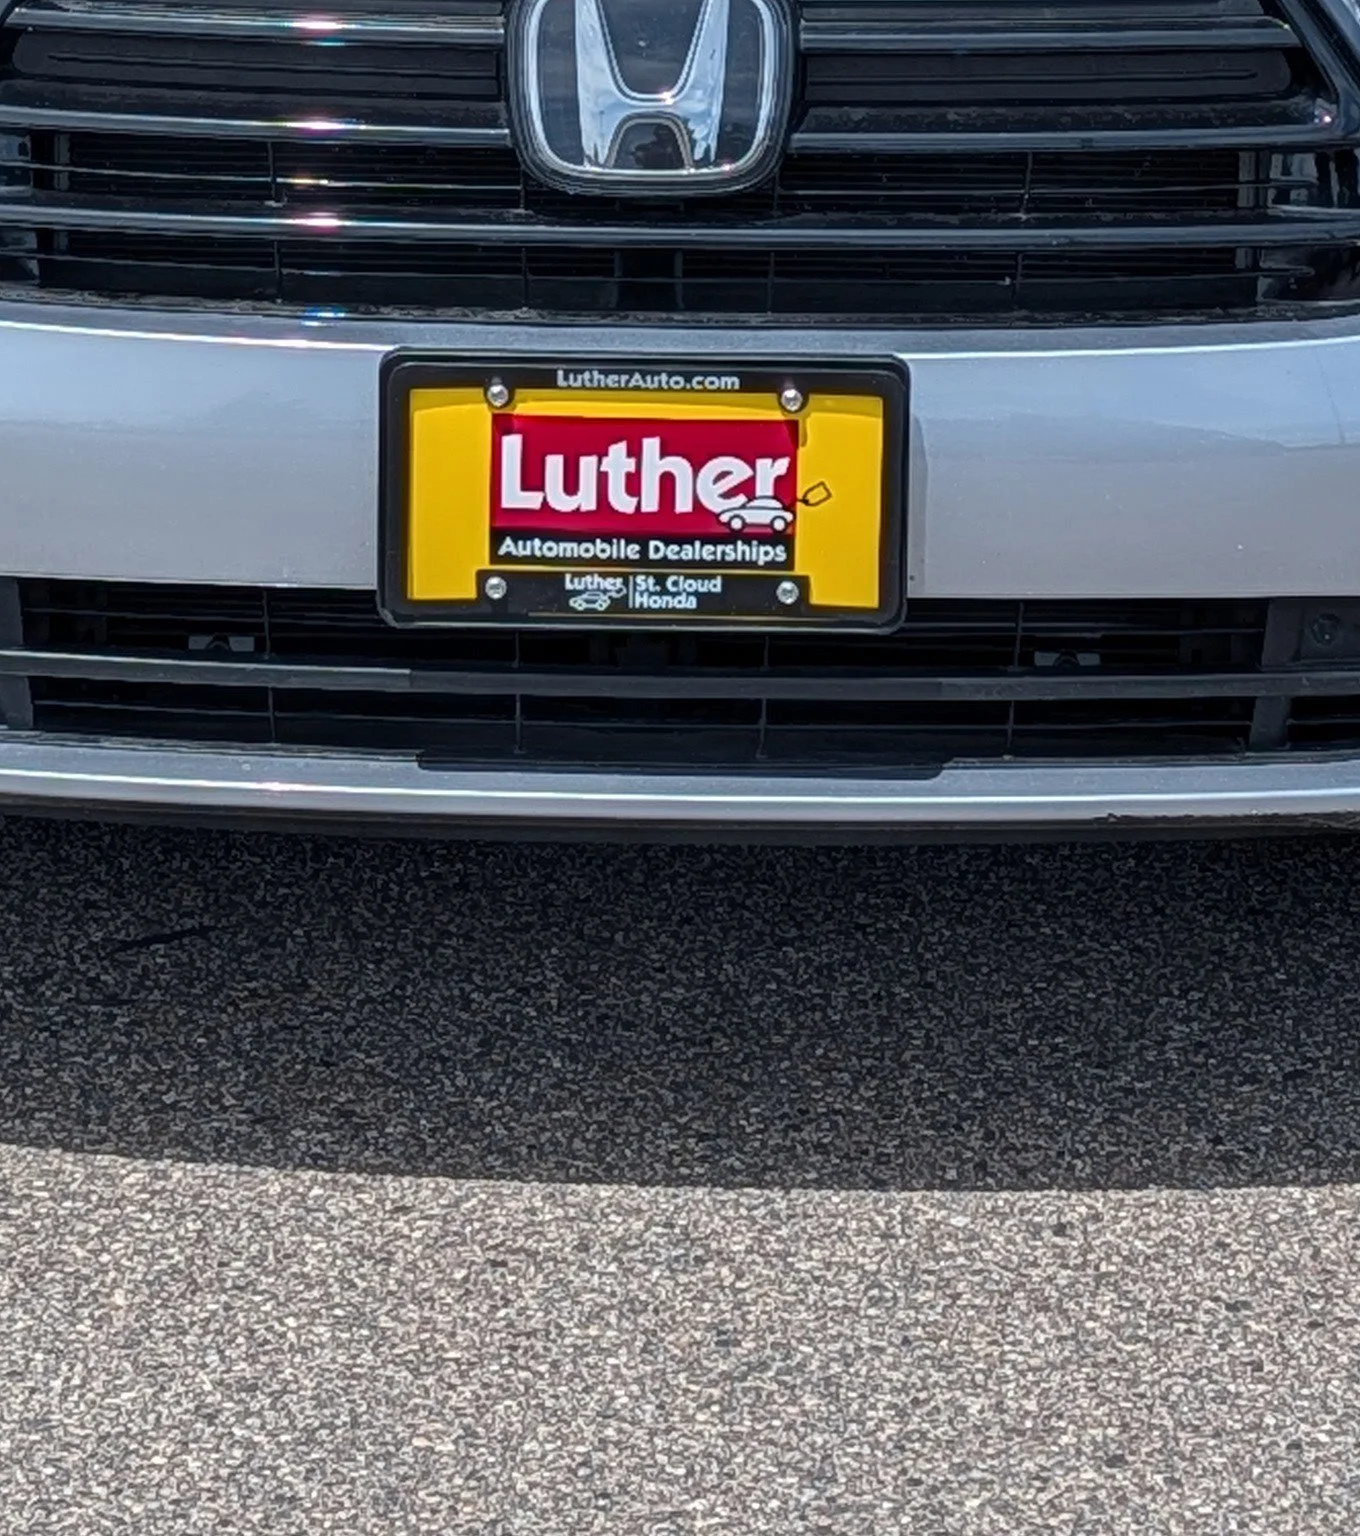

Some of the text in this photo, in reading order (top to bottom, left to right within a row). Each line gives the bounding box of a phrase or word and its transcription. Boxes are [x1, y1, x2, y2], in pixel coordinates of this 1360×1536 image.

[557, 369, 740, 390] LutherAuto.com
[501, 434, 790, 514] Luther
[498, 536, 787, 566] Automobile Dealerships
[565, 573, 623, 590] Luther
[635, 575, 722, 592] St. Cloud
[635, 592, 697, 609] Honda
